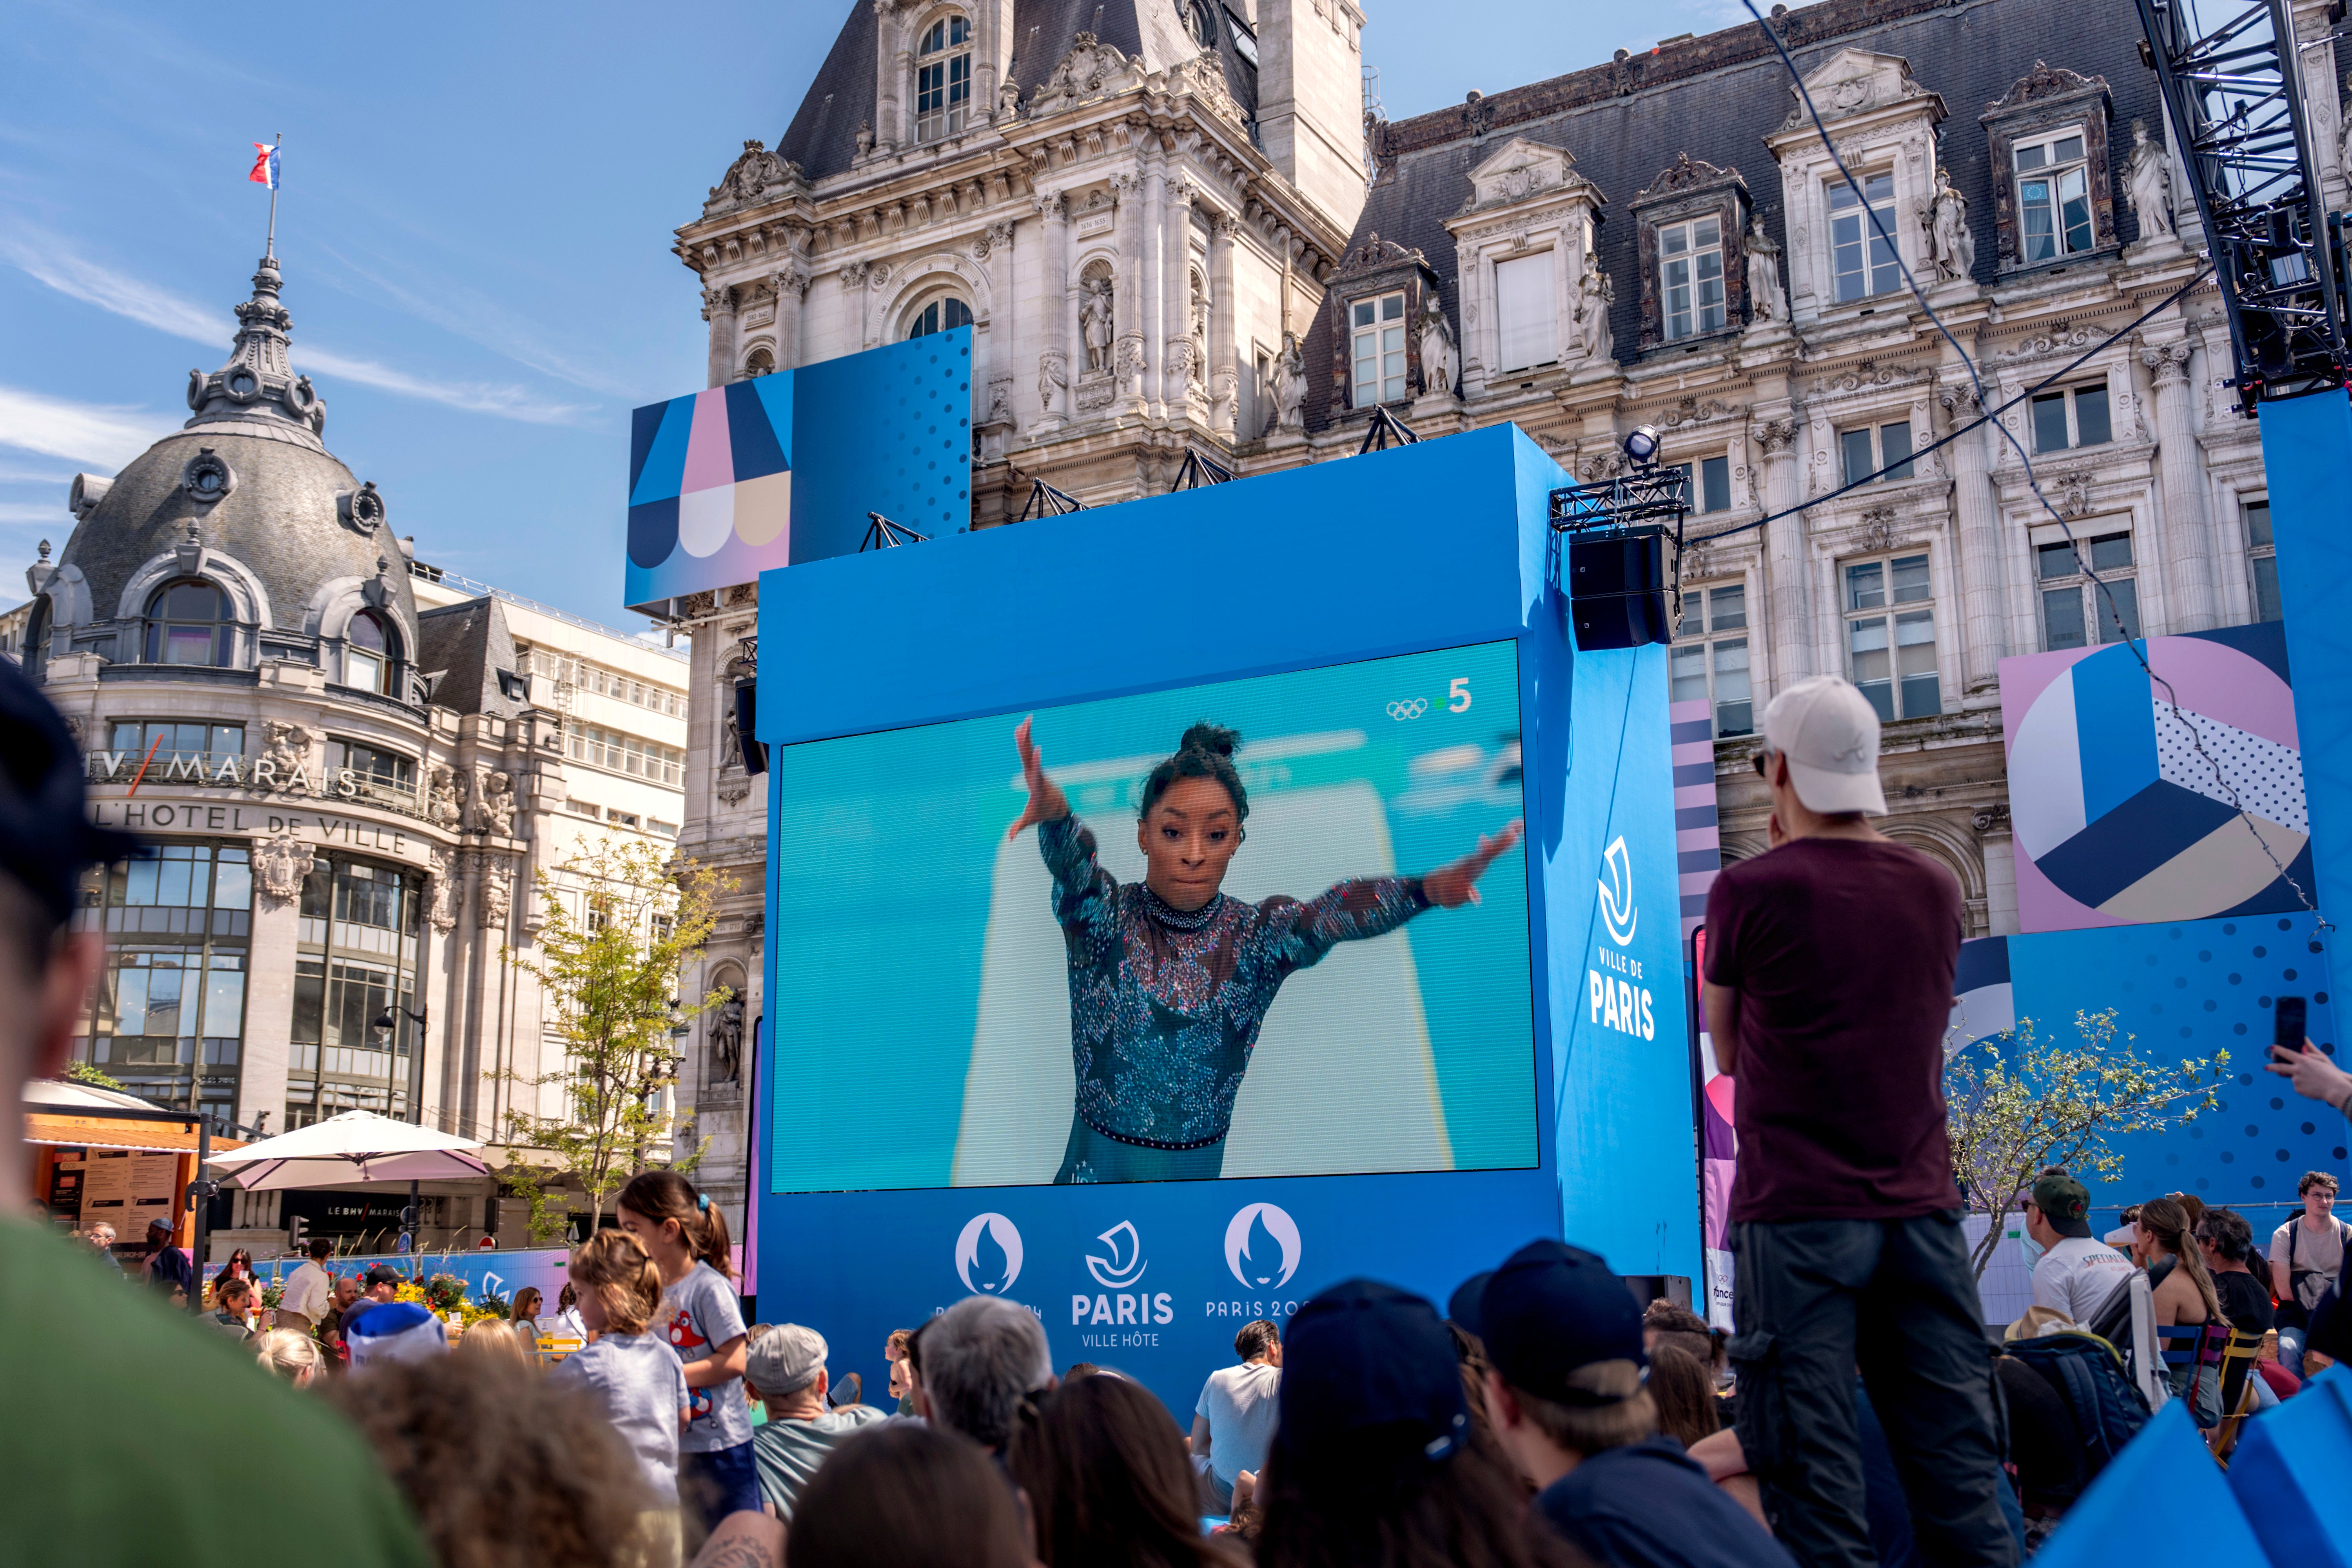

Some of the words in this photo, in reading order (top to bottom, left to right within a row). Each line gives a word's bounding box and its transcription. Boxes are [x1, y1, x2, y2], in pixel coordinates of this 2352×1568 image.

[1448, 677, 1472, 713] 5
[95, 804, 249, 830] L'HOTEL
[269, 816, 301, 835] DE
[318, 817, 406, 854] VILLE
[1599, 946, 1627, 973] VILLE
[1631, 959, 1643, 979] DE
[1590, 969, 1655, 1041] PARIS
[328, 1207, 340, 1215] LE
[1072, 1292, 1174, 1325] PARIS
[1271, 1300, 1310, 1316] 20
[1082, 1334, 1118, 1347] VILLE
[1122, 1331, 1159, 1347] HÔTE
